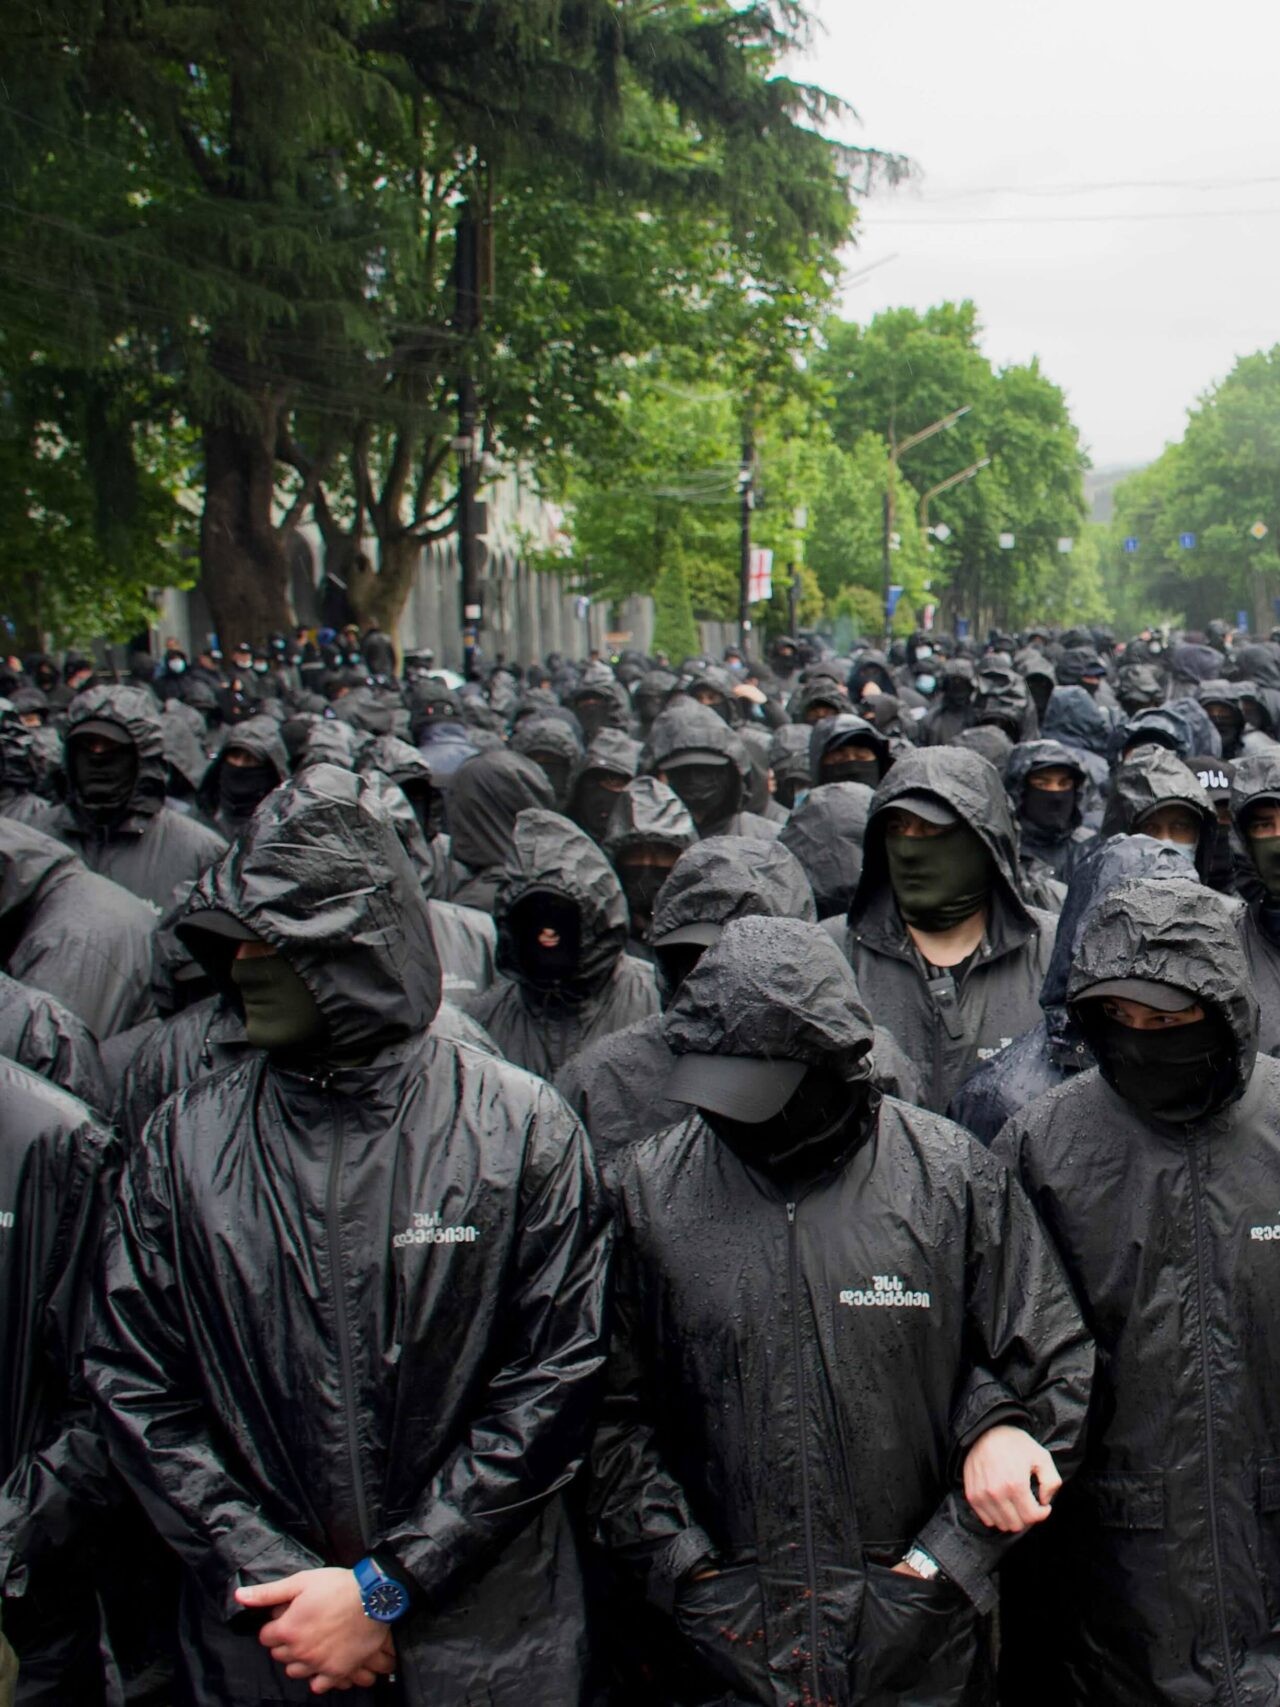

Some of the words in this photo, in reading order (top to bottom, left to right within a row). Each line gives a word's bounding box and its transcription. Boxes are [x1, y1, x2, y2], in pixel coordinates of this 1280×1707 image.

[1197, 770, 1229, 788] შსს
[413, 1210, 443, 1227] შსს
[871, 1275, 904, 1292] შსს
[840, 1289, 931, 1309] დეტექტივი
